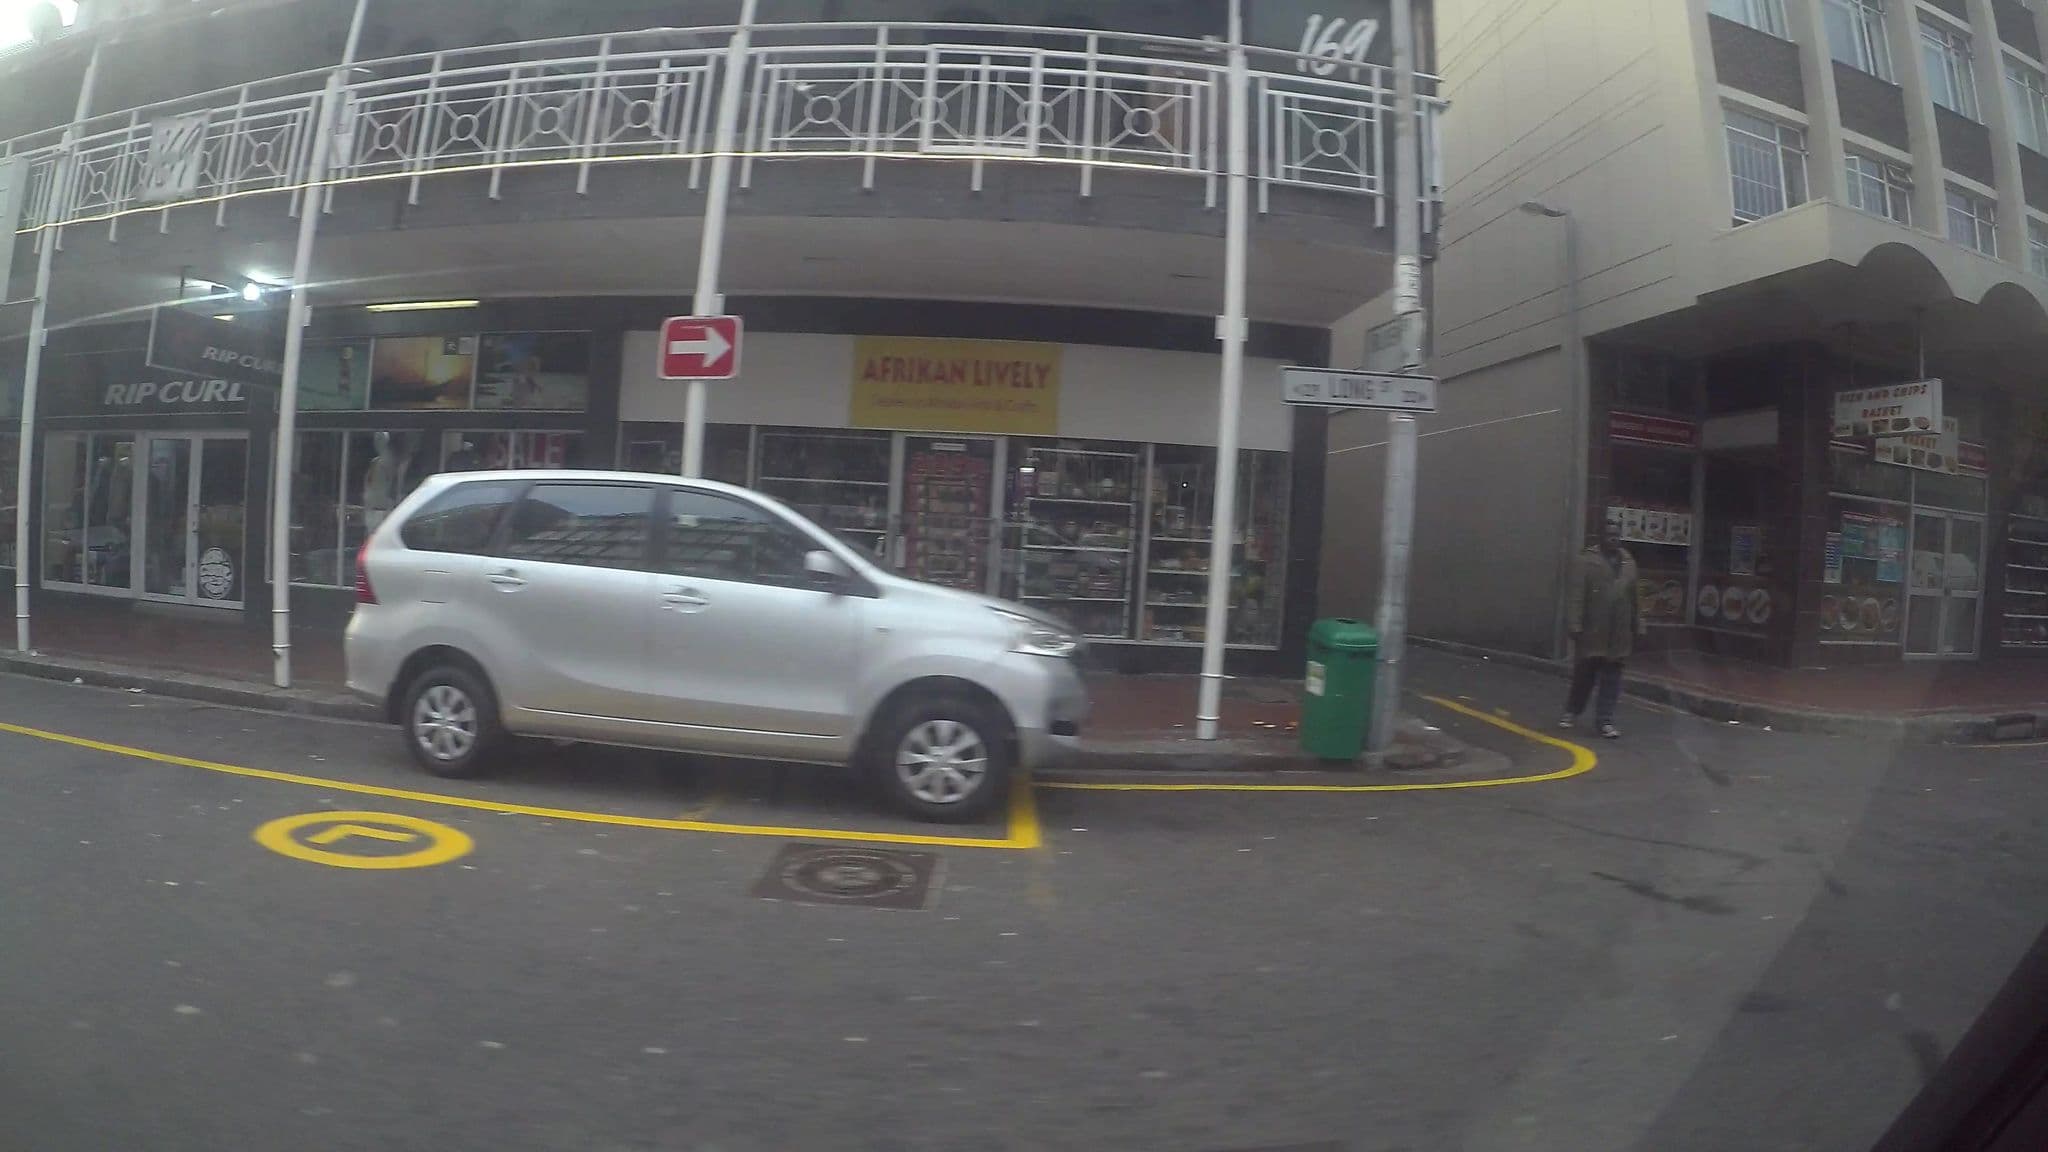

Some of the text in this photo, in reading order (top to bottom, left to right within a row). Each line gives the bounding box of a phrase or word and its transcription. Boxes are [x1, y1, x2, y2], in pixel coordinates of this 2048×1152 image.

[1296, 14, 1378, 80] 169
[203, 347, 239, 363] RIP
[863, 357, 1051, 388] AFRIKAN LIVELY
[105, 380, 245, 405] RIP CURL
[1328, 376, 1376, 401] LONG
